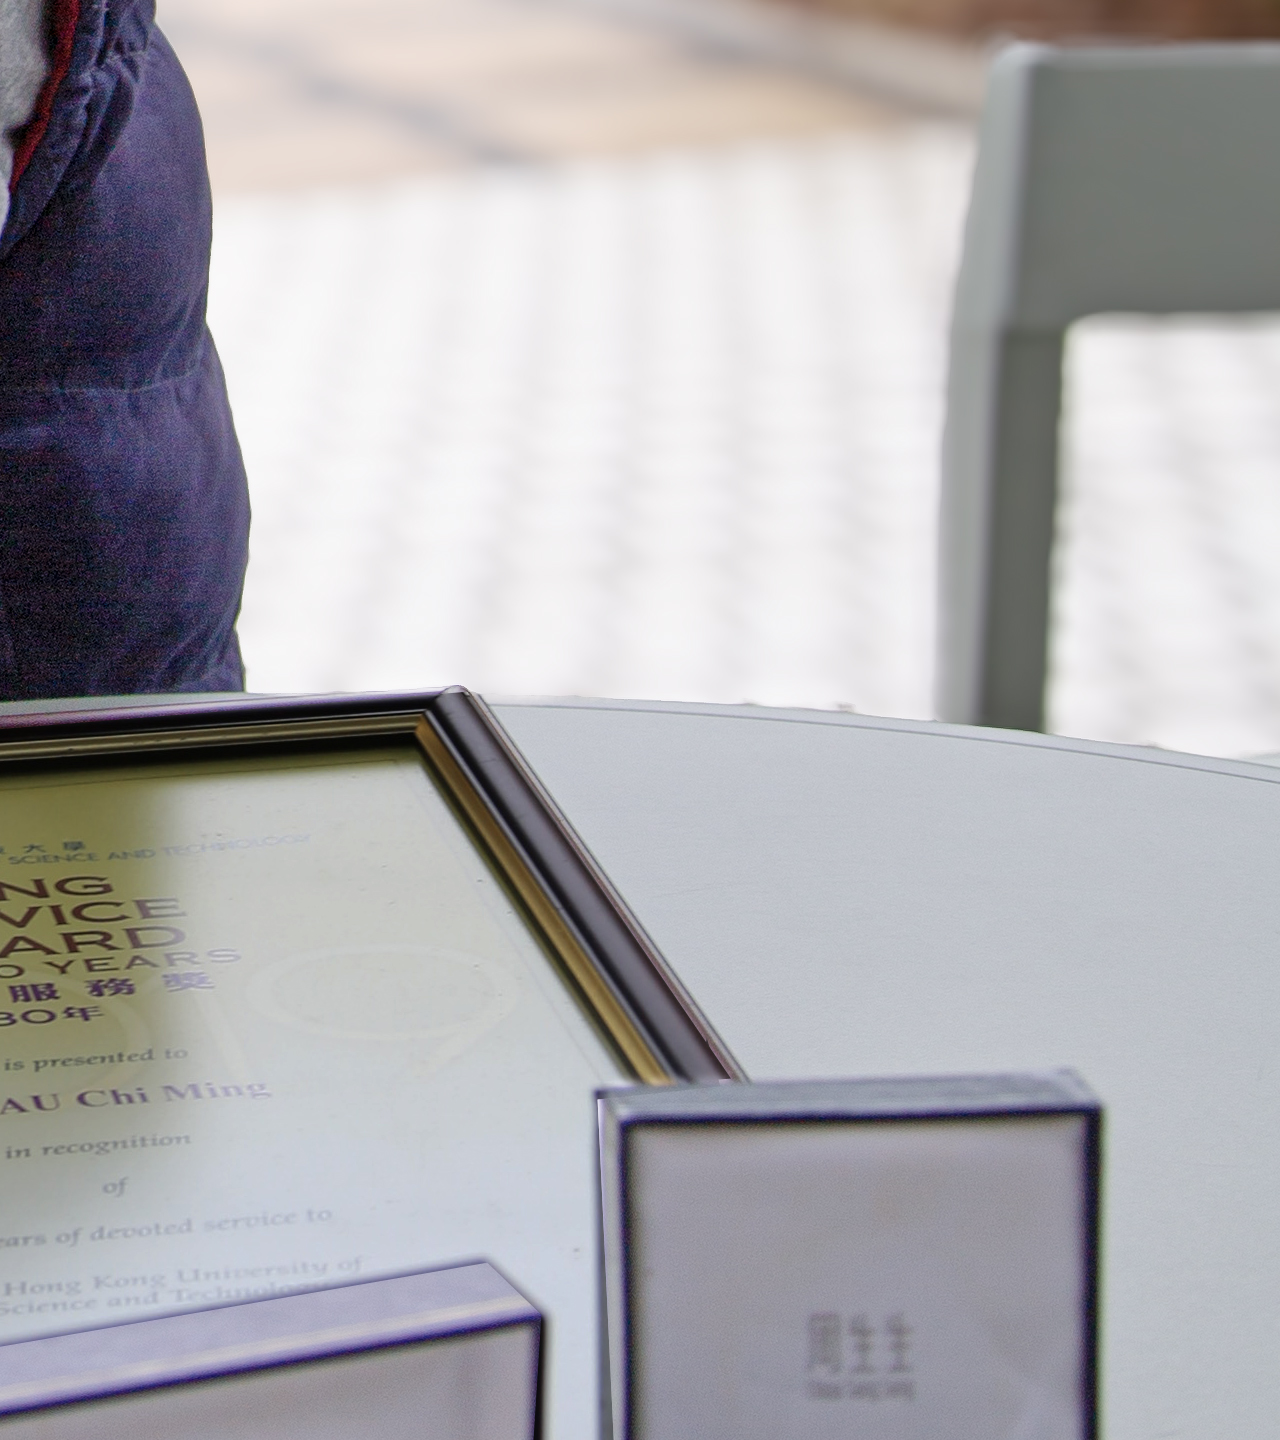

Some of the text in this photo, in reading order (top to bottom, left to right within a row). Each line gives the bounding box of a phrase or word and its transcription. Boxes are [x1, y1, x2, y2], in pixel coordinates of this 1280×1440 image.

[7, 851, 101, 867] SCIENCE
[107, 847, 156, 862] AND
[161, 832, 313, 858] TECHNOLOGY
[41, 946, 243, 976] YEARS
[3, 1056, 27, 1073] is
[32, 1046, 157, 1075] presented
[164, 1046, 189, 1061] to
[75, 1086, 150, 1109] Chi
[163, 1078, 275, 1102] Ming
[4, 1131, 192, 1161] in recognition
[101, 1176, 129, 1199] of
[55, 1226, 85, 1249] of
[90, 1217, 195, 1243] devoted
[202, 1210, 299, 1234] service
[305, 1206, 334, 1223] to
[3, 1277, 82, 1302] Hong
[92, 1270, 168, 1293] Kong
[176, 1259, 330, 1285] University
[338, 1254, 367, 1274] of
